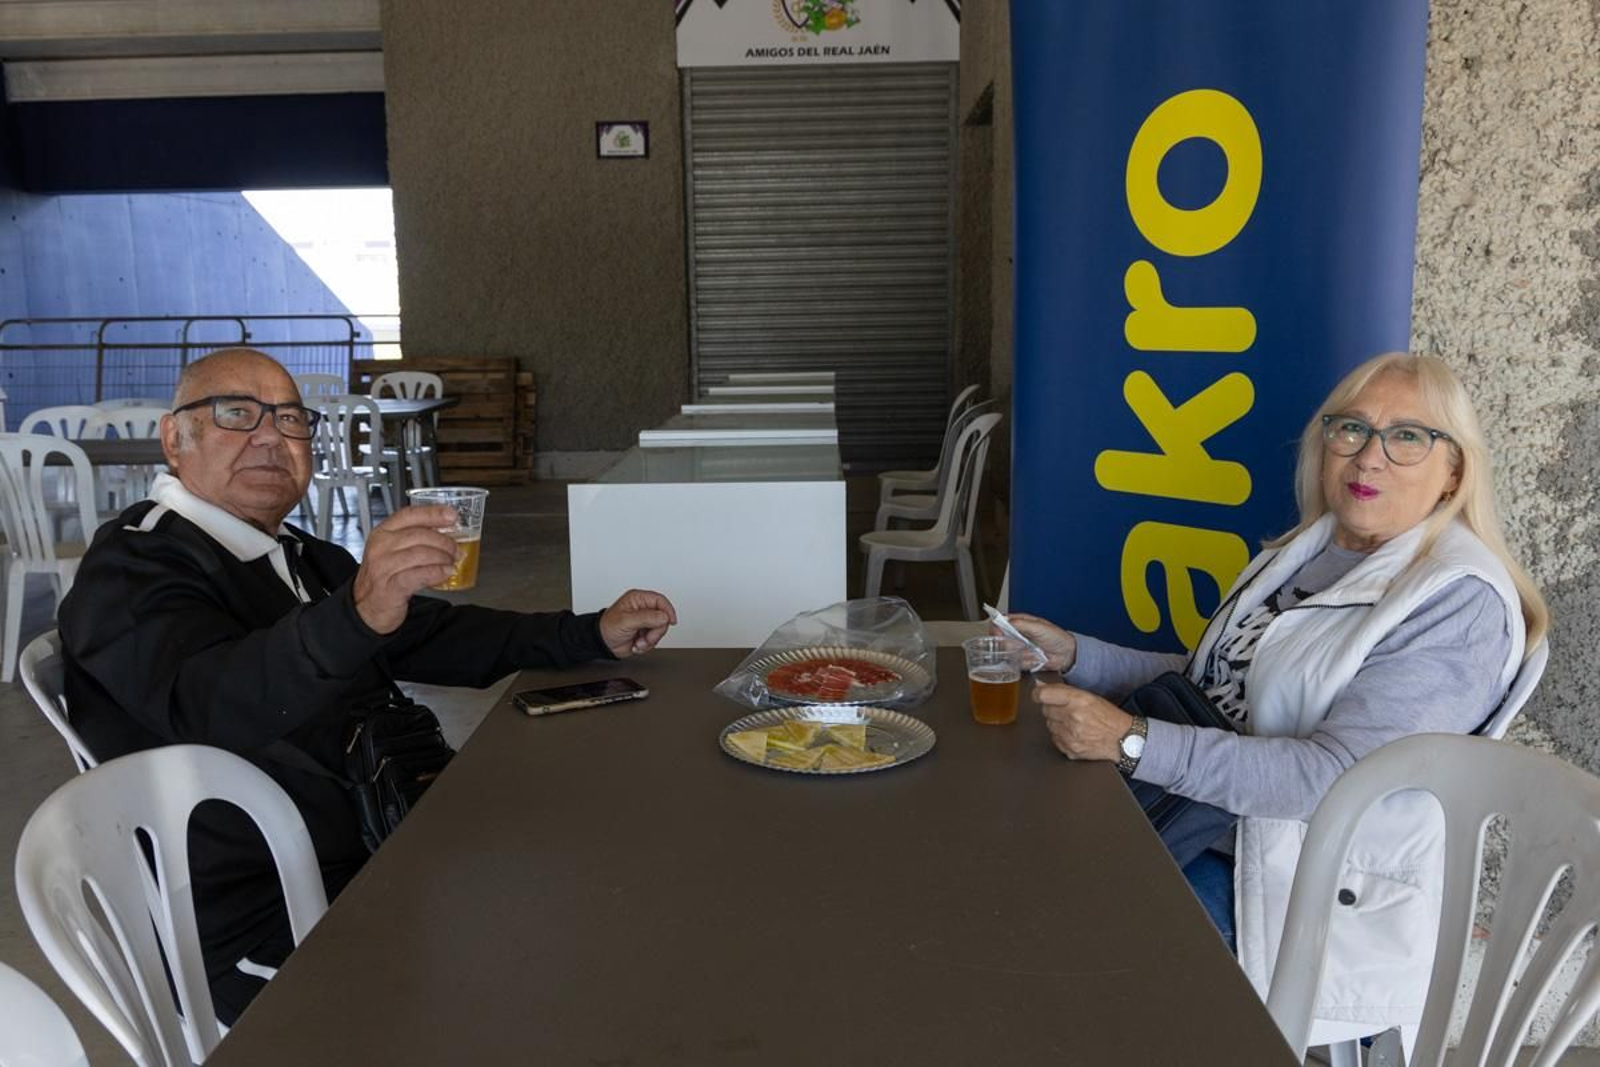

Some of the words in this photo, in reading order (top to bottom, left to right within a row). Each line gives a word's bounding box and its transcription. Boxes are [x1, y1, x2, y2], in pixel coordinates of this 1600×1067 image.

[745, 47, 794, 58] AMIGOS
[797, 47, 820, 57] DEL
[823, 45, 854, 56] REAL
[858, 43, 890, 55] JAÉN
